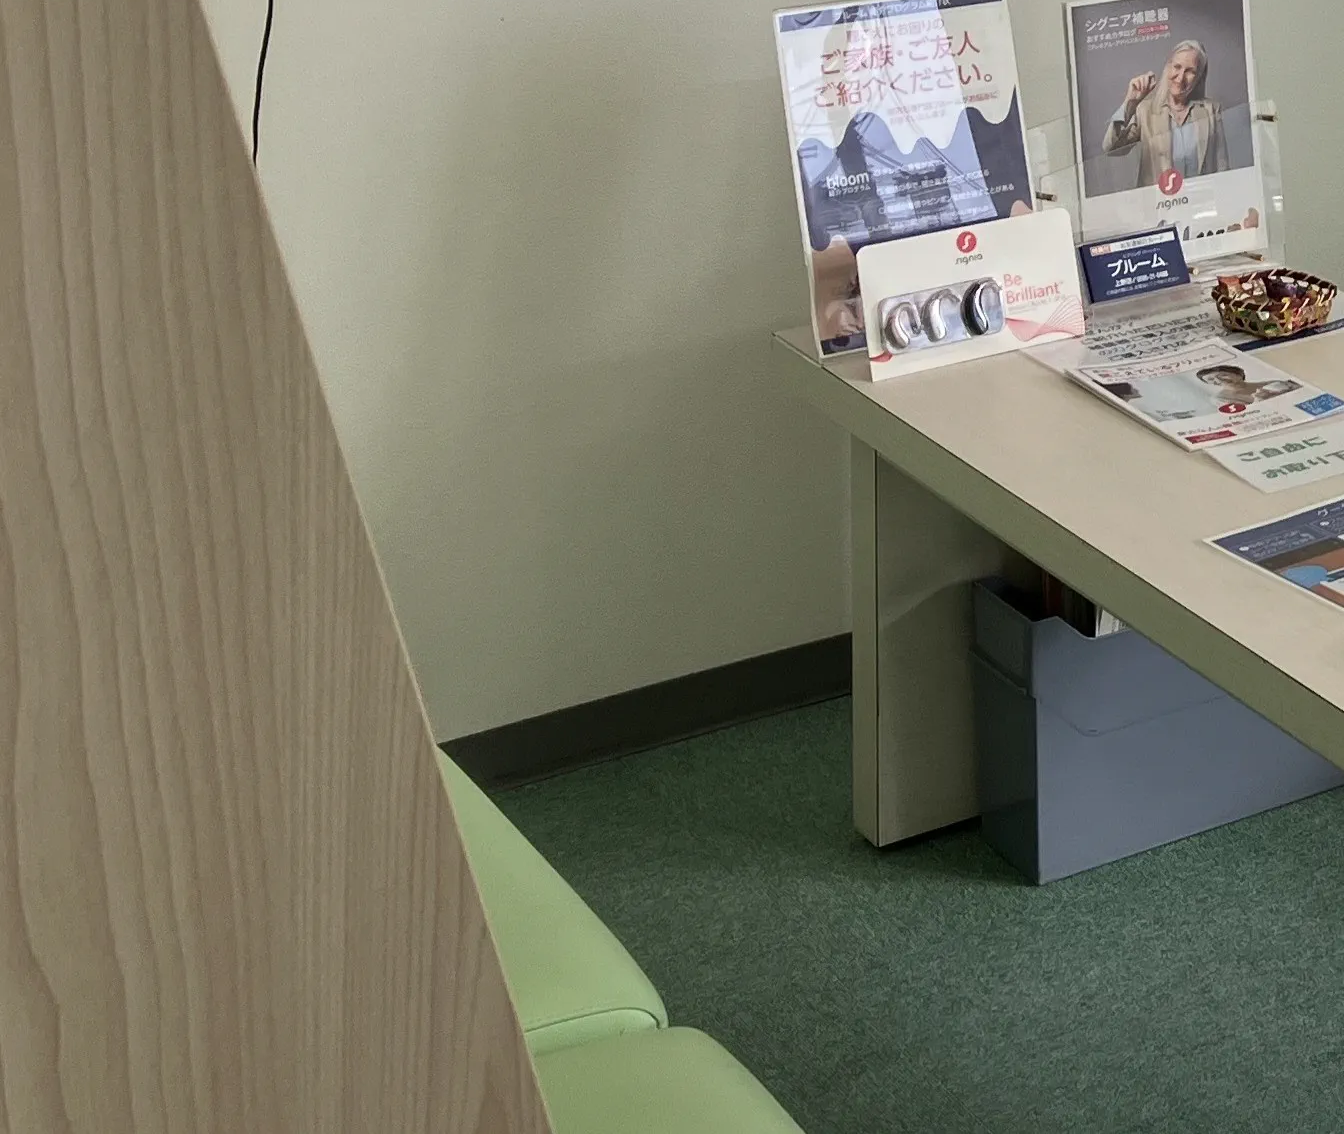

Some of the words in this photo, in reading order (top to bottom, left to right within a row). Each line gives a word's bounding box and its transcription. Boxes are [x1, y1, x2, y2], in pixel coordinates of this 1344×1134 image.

[1085, 8, 1169, 33] シグニア補聴器
[821, 30, 980, 75] ご家族・ご友人
[814, 62, 993, 108] ご紹介ください。
[826, 171, 870, 191] bloom
[1156, 197, 1189, 210] signia
[955, 254, 983, 265] signia
[1107, 253, 1166, 278] ブルーム
[1003, 273, 1022, 287] Be
